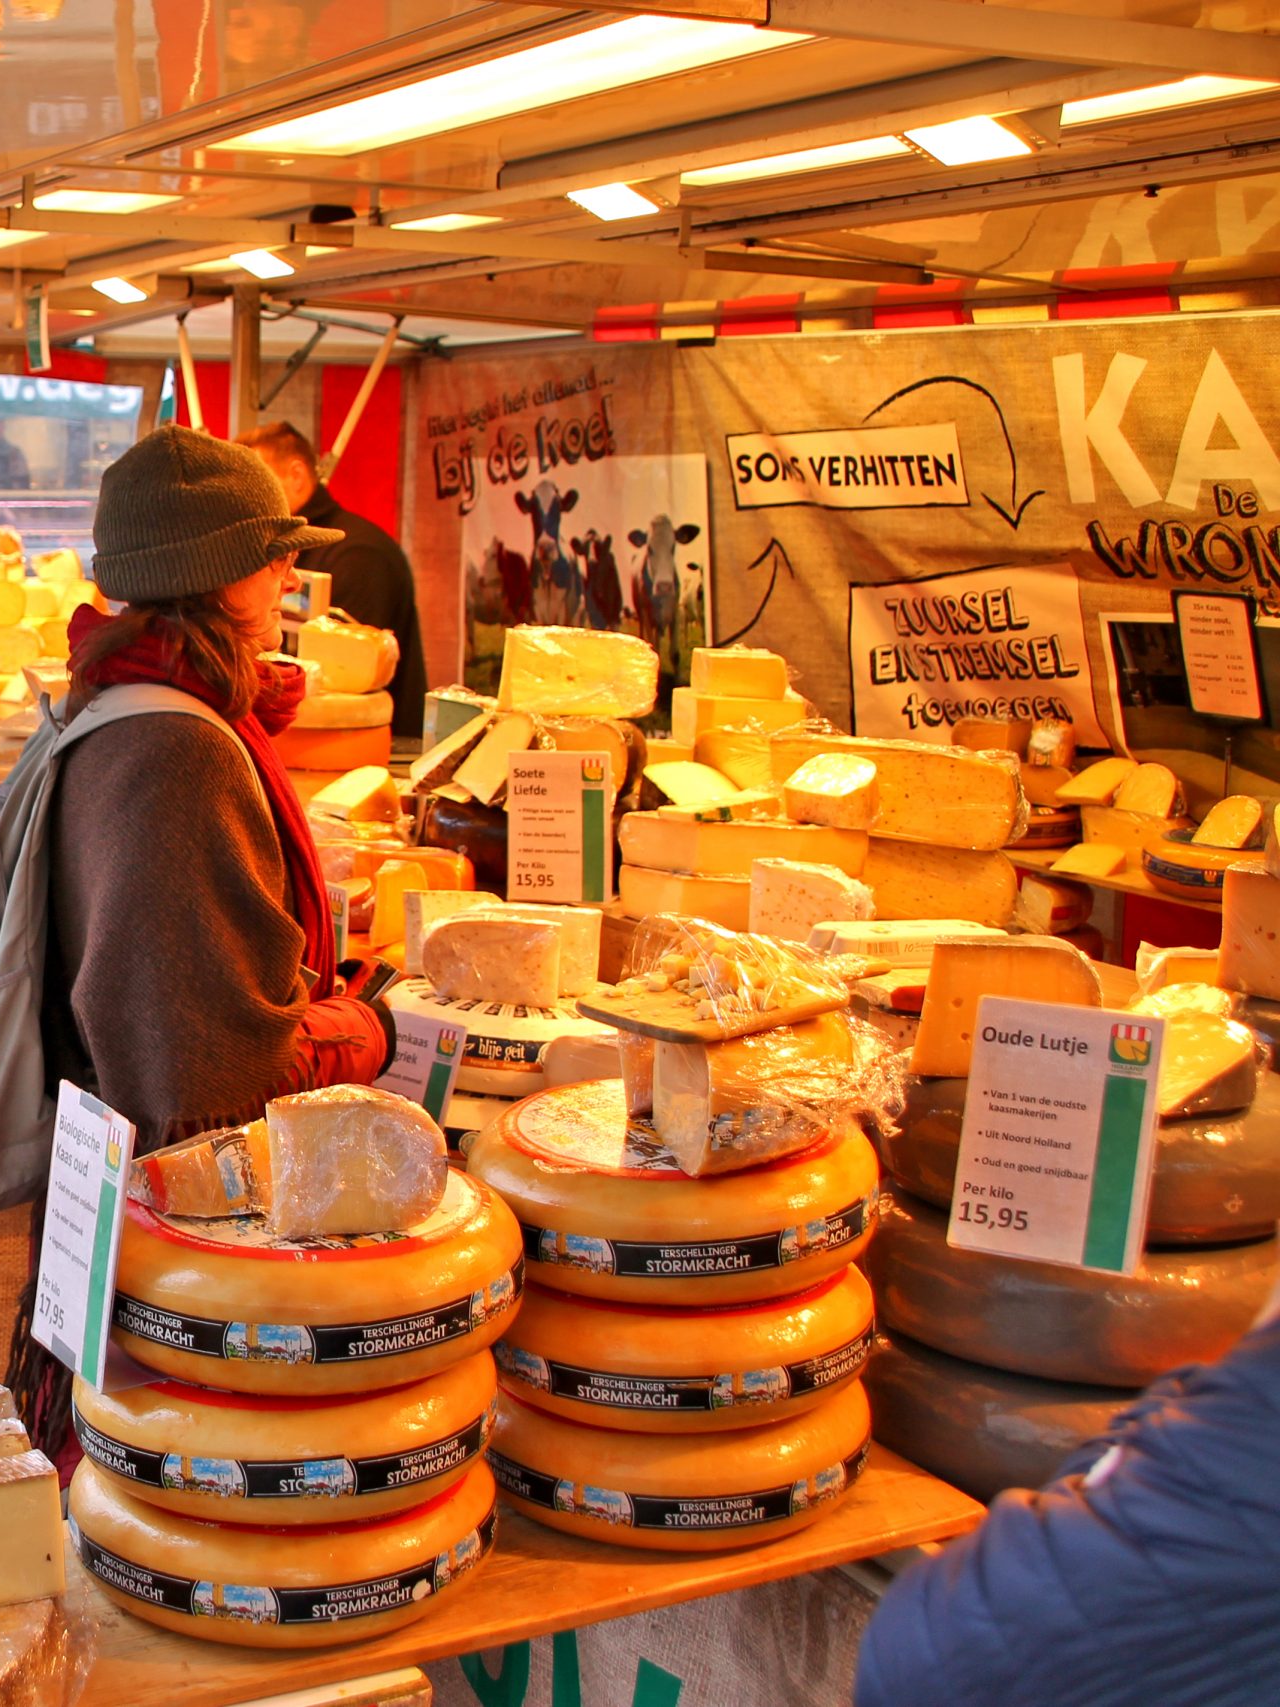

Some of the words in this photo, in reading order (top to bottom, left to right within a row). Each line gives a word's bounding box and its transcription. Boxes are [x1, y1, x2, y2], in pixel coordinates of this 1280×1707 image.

[487, 426, 529, 485] de
[809, 453, 958, 487] VERHITTEN
[1212, 484, 1259, 518] De
[885, 586, 1030, 637] ZUURSEL
[513, 768, 545, 779] Soete
[513, 784, 548, 796] Liefde
[517, 861, 529, 869] Per
[516, 874, 555, 888] 15,95
[479, 1037, 503, 1060] blije
[504, 1043, 526, 1062] geit
[981, 1025, 1035, 1048] Oude
[1039, 1033, 1089, 1057] Lutje
[988, 1102, 1058, 1121] kaasmakerijen
[990, 1089, 1009, 1100] Van
[1011, 1091, 1017, 1101] 1
[1019, 1094, 1037, 1104] van
[1039, 1095, 1052, 1106] de
[1053, 1098, 1087, 1111] oudste
[59, 1113, 101, 1155] Biologische
[985, 1129, 1000, 1140] Uit
[1001, 1132, 1031, 1145] Noord
[1033, 1136, 1072, 1151] Holland
[55, 1141, 72, 1168] Kaas
[73, 1154, 90, 1178] oud
[981, 1156, 1001, 1168] Oud
[1003, 1160, 1016, 1170] en
[1017, 1161, 1042, 1174] goed
[1043, 1165, 1089, 1181] snijdbaar
[963, 1181, 986, 1196] Per
[988, 1184, 1015, 1201] kilo
[958, 1200, 1029, 1231] 15,95
[646, 1254, 752, 1274] STORMKRACHT
[659, 1245, 737, 1259] TERSCHELLINGER
[41, 1270, 51, 1290] Per
[50, 1277, 61, 1298] kilo
[37, 1290, 65, 1335] 17,95
[125, 1302, 183, 1329] TERSCHELLINGER
[117, 1309, 195, 1348] STORMKRACHT
[348, 1324, 447, 1356] STORMKRACHT
[362, 1315, 436, 1339] TERSCHELLINGER
[577, 1384, 680, 1407] STORMKRACHT
[589, 1375, 665, 1392] TERSCHELLINGER
[386, 1446, 467, 1486] STORMKRACHT
[399, 1438, 459, 1469] TERSCHELLINGER
[664, 1507, 765, 1526] STORMKRACHT
[678, 1499, 753, 1513] TERSCHELLINGER
[93, 1560, 165, 1602] STORMKRACHT
[100, 1552, 153, 1585] TERSCHELLINGER
[311, 1586, 412, 1619] STORMKRACHT
[325, 1579, 400, 1602] TERSCHELLINGER
